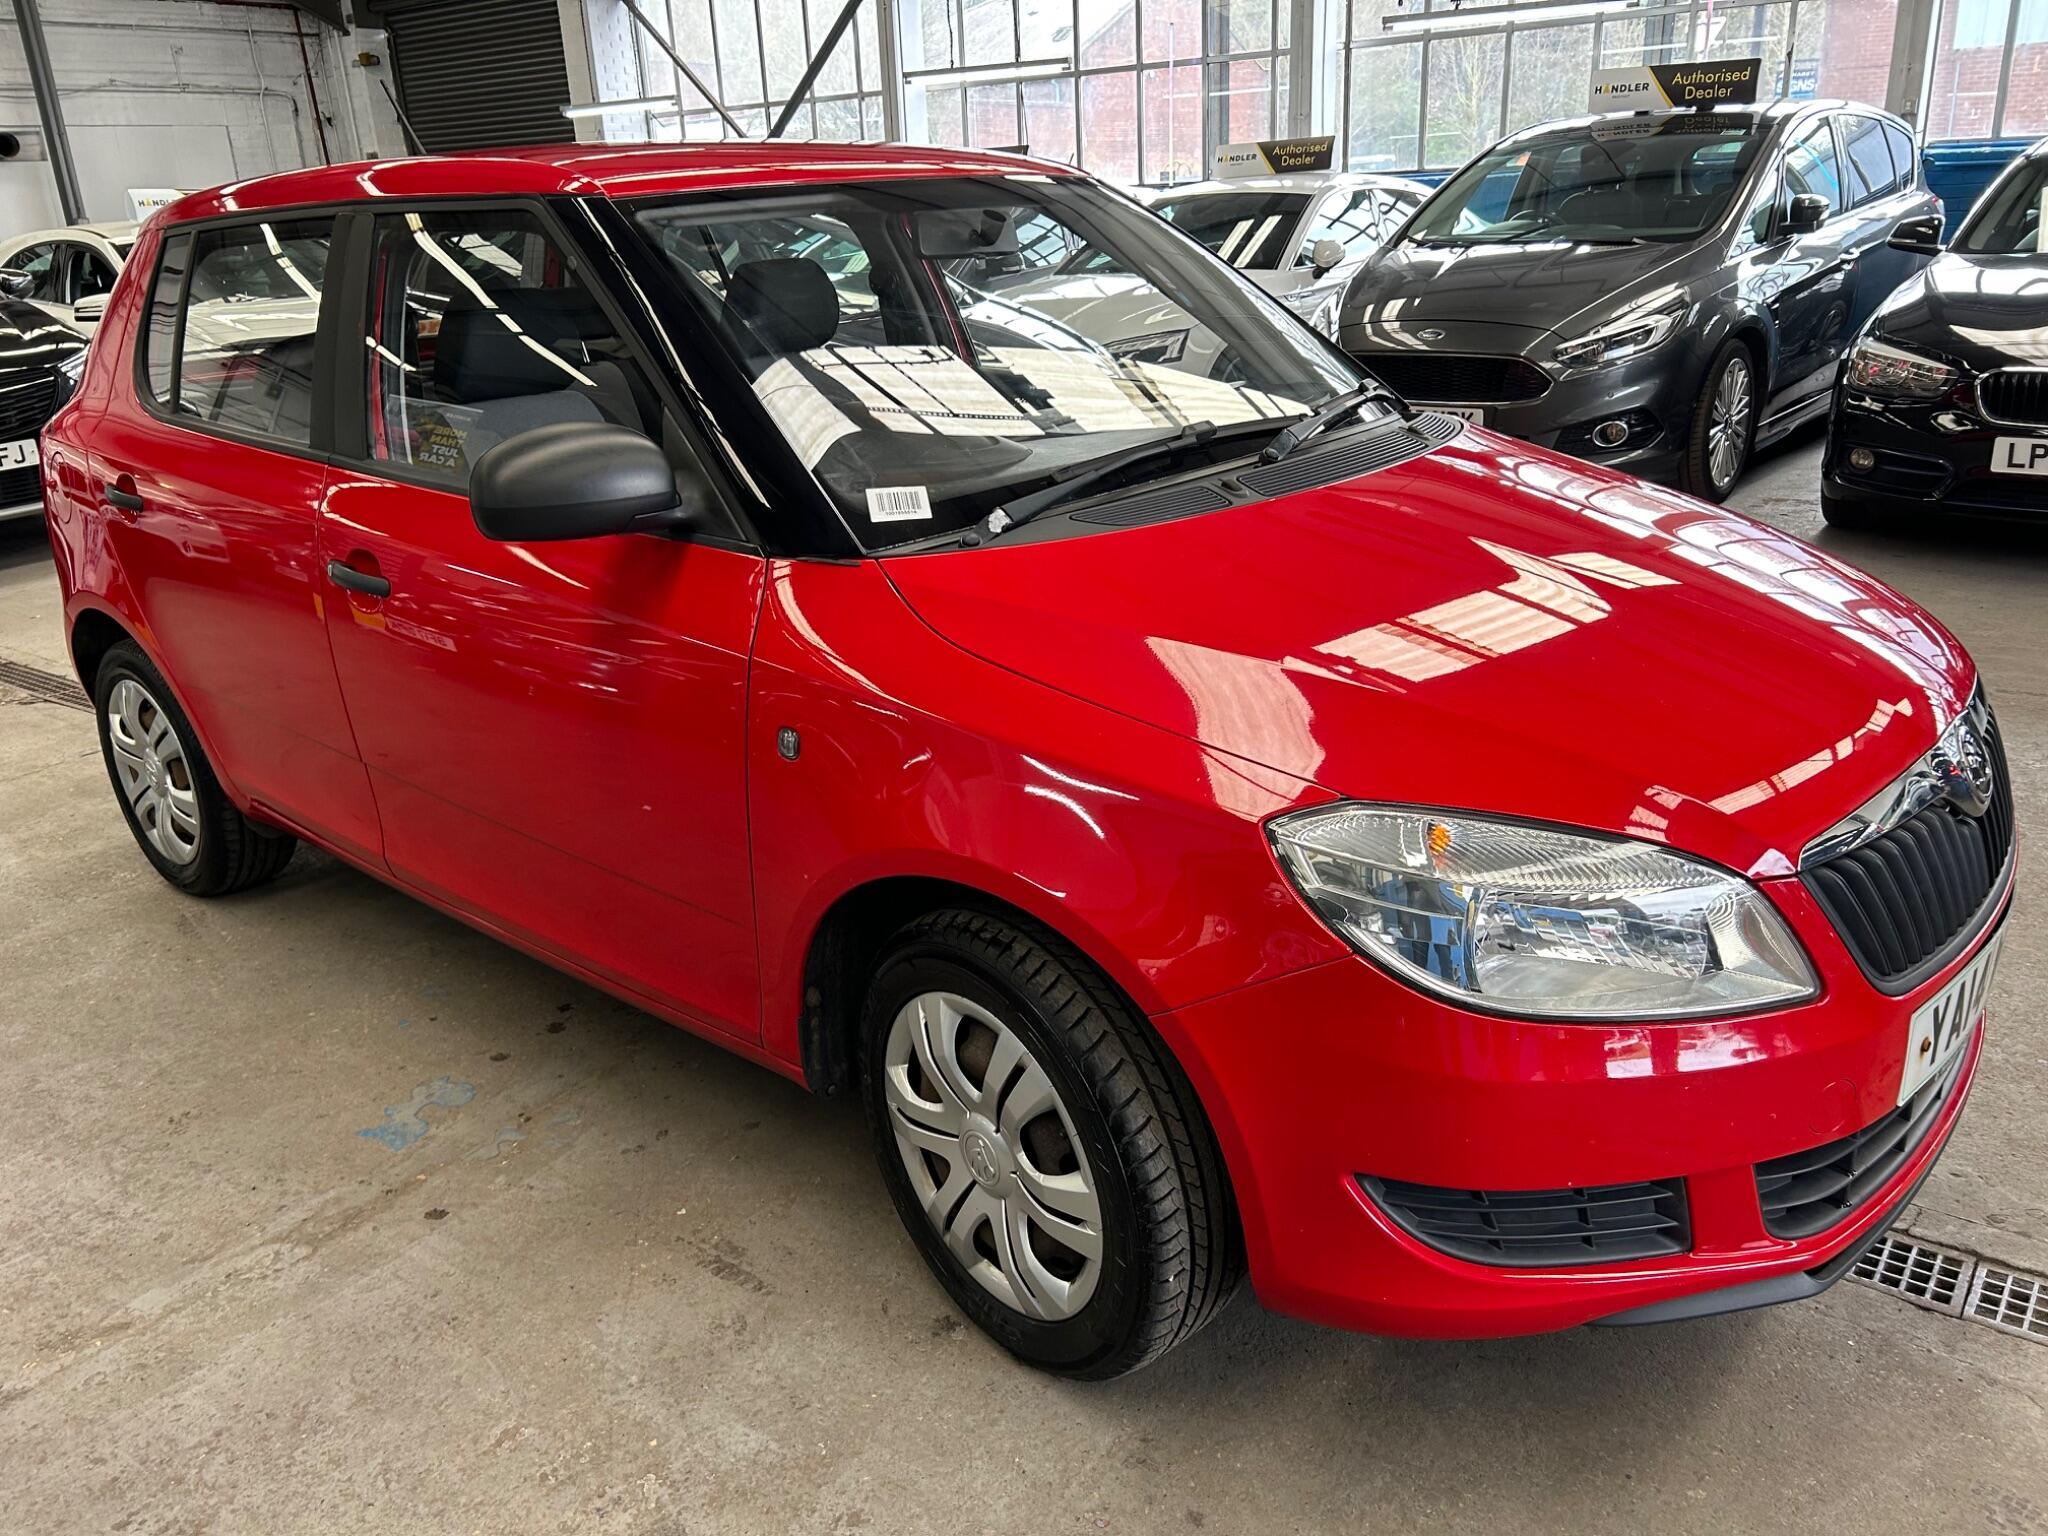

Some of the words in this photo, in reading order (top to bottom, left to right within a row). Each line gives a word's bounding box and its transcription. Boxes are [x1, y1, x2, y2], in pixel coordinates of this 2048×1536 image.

[1672, 66, 1751, 85] Authorised
[1594, 82, 1650, 95] HANDLER
[1776, 79, 1815, 92] SGNS
[1685, 85, 1733, 100] Dealer
[1273, 141, 1328, 155] Authorised
[1281, 155, 1316, 166] Dealer
[138, 198, 169, 207] HAND
[2007, 442, 2048, 469] LP
